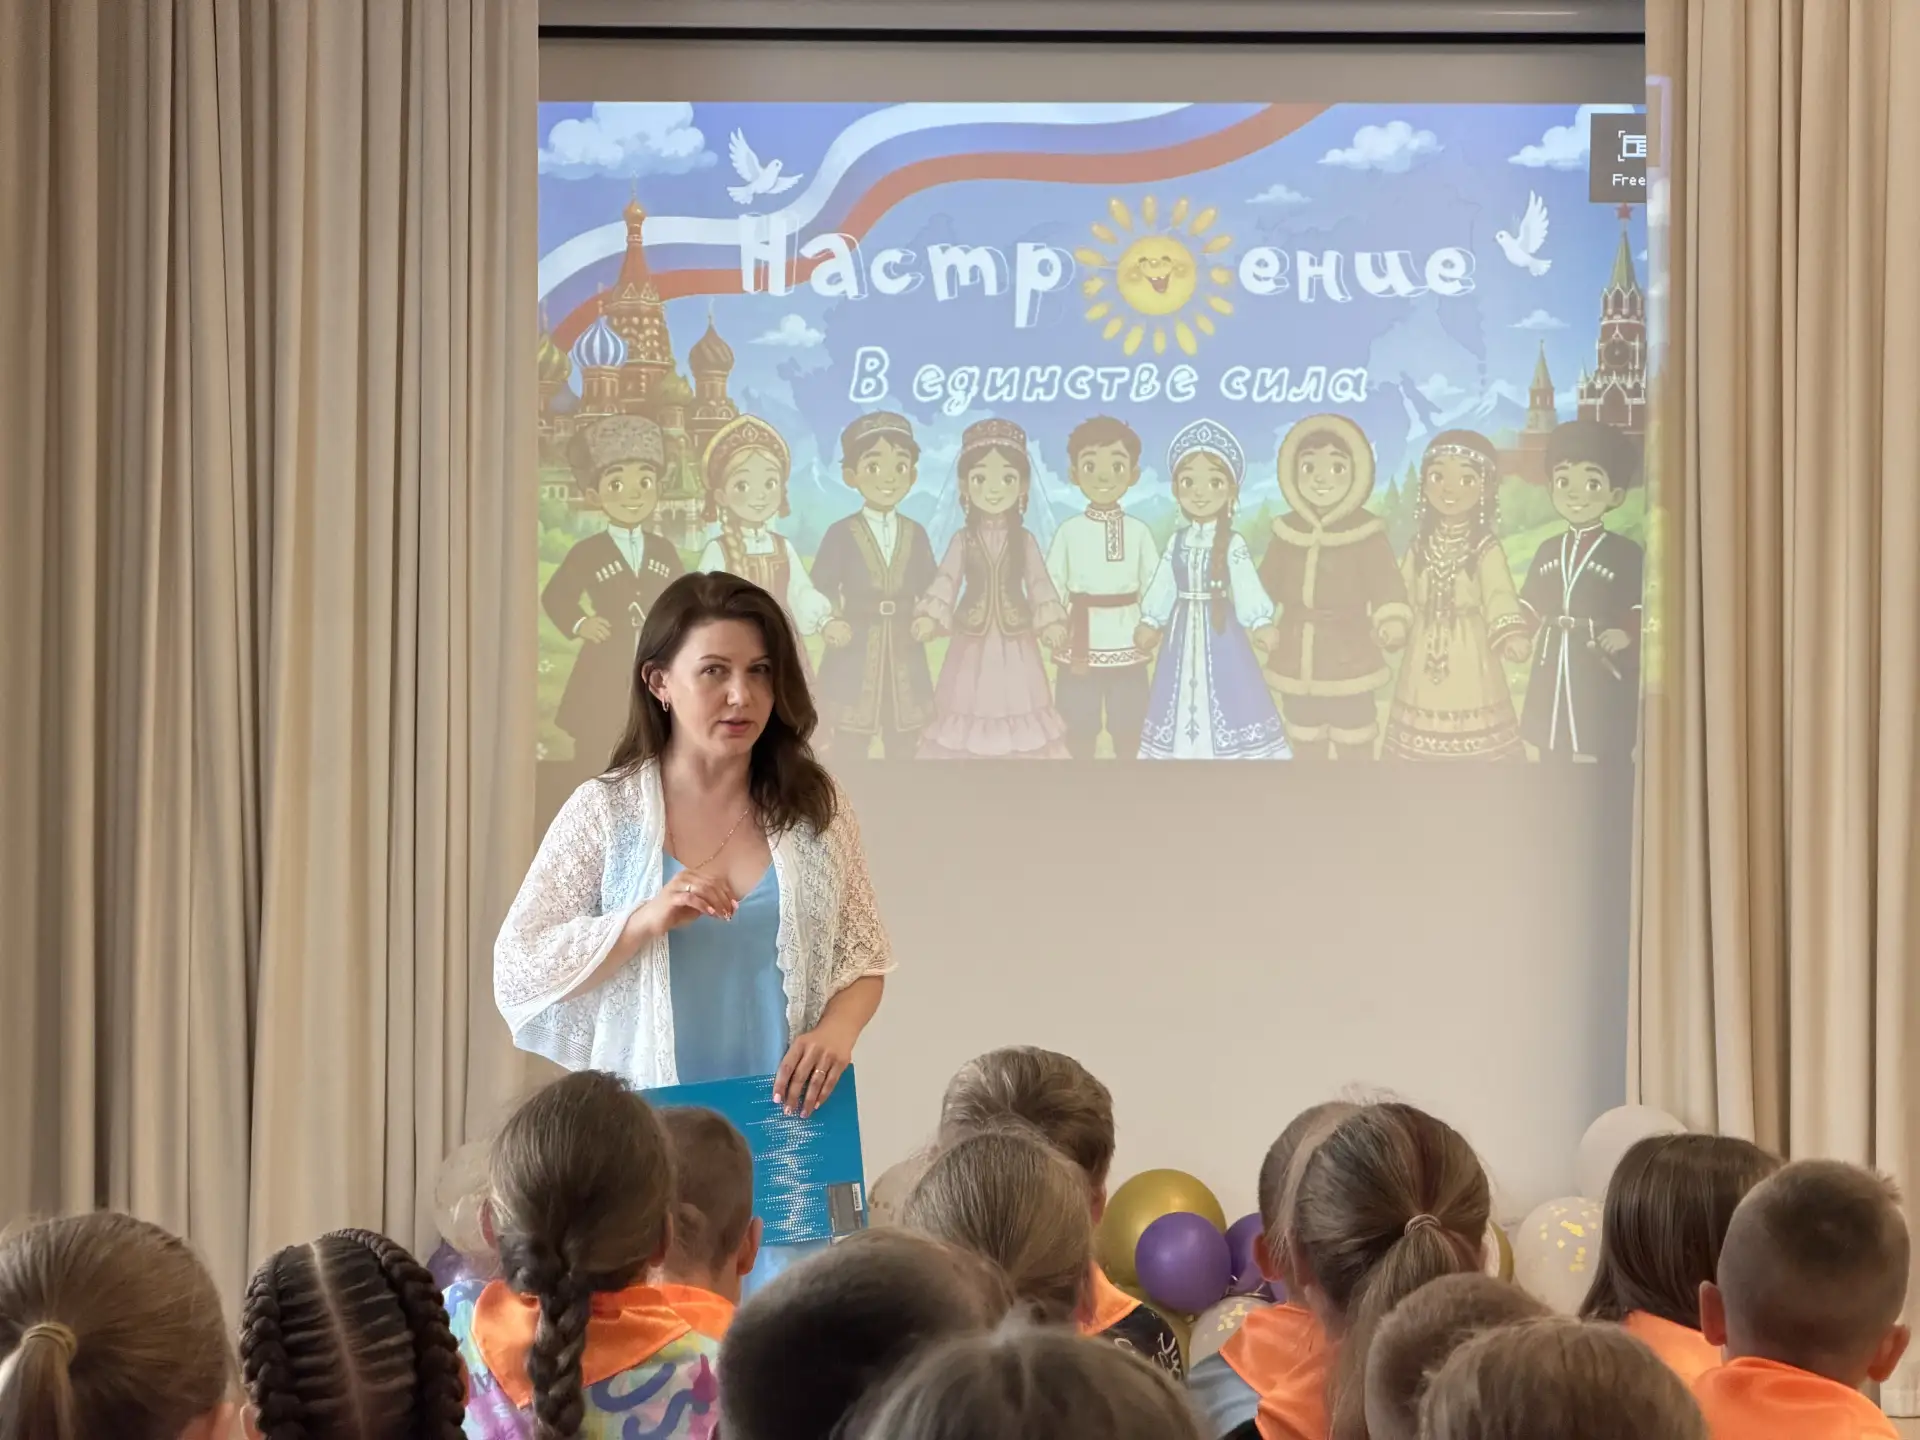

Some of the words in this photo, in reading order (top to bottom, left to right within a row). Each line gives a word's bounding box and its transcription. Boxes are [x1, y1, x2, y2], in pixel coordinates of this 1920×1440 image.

[849, 346, 890, 403] В
[912, 364, 1198, 417] единстве
[1220, 366, 1368, 403] сила
